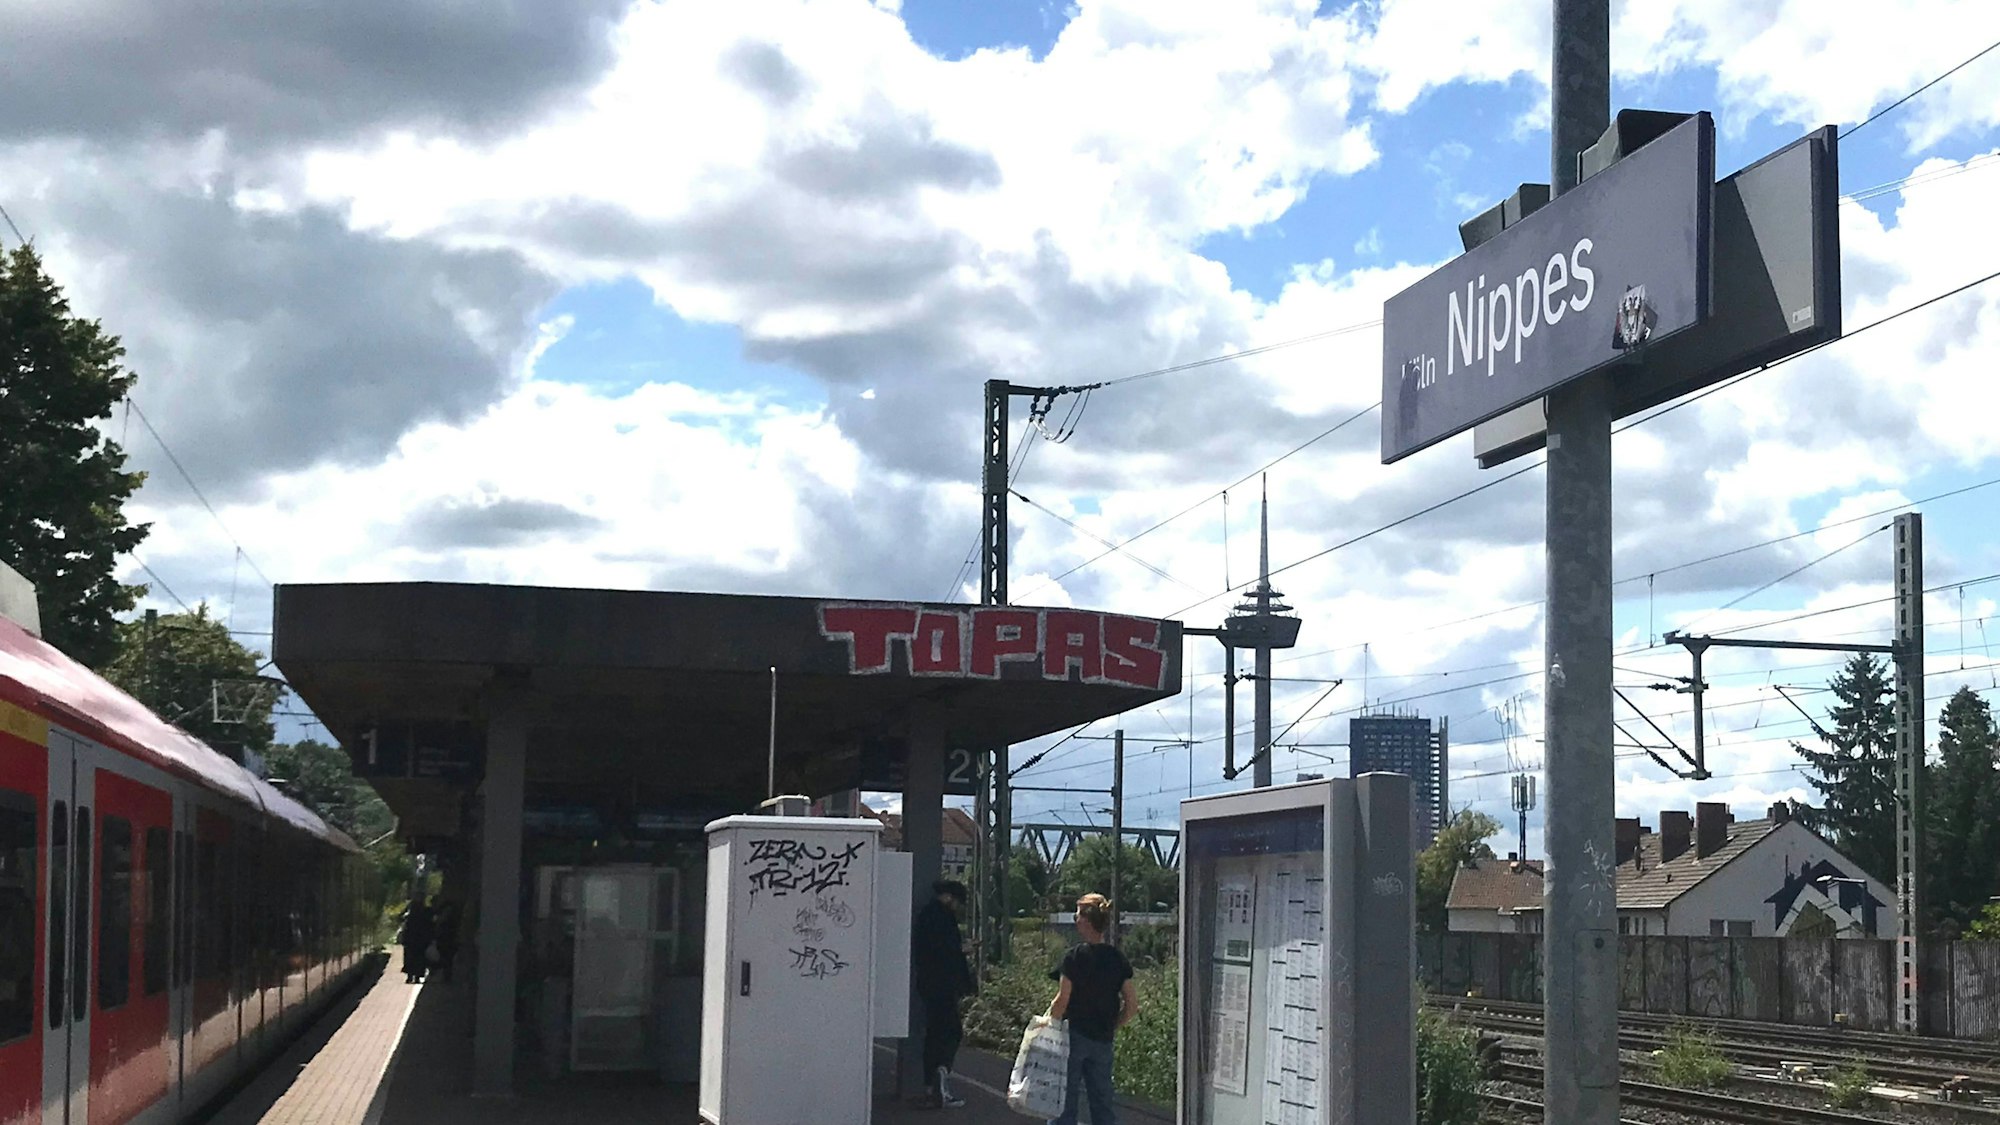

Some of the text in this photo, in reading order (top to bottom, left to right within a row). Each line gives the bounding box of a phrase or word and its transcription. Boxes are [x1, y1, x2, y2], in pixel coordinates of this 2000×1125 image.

[1447, 237, 1595, 376] Nippes
[818, 603, 1166, 690] TOPAS
[361, 728, 377, 765] 1
[947, 748, 971, 784] 2
